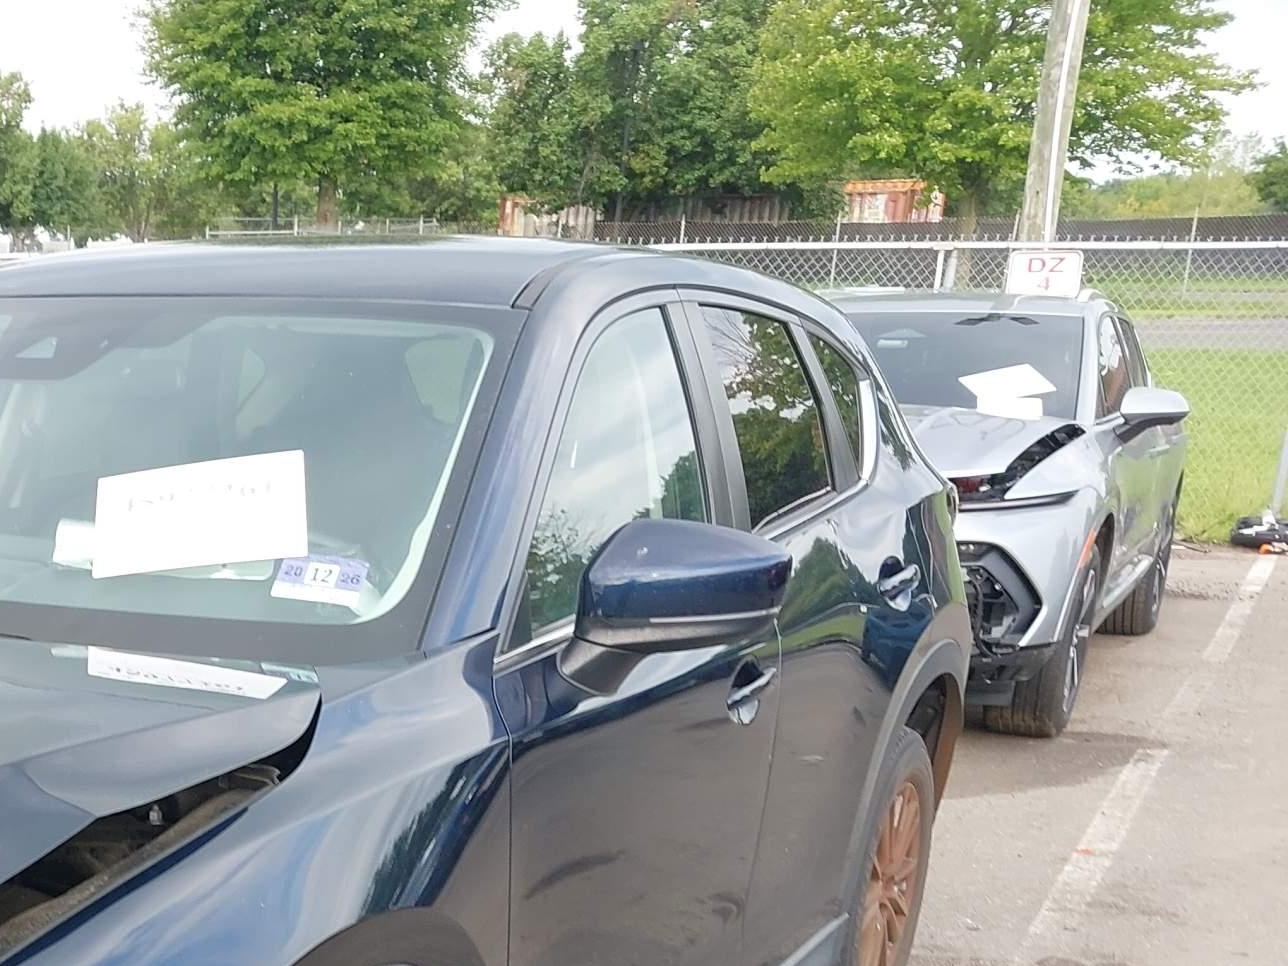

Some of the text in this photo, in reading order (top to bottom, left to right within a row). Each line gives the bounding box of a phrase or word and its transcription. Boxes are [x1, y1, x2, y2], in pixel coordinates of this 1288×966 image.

[1028, 257, 1066, 273] DZ
[1037, 276, 1049, 291] 4
[310, 567, 333, 583] 12
[339, 572, 361, 585] 26
